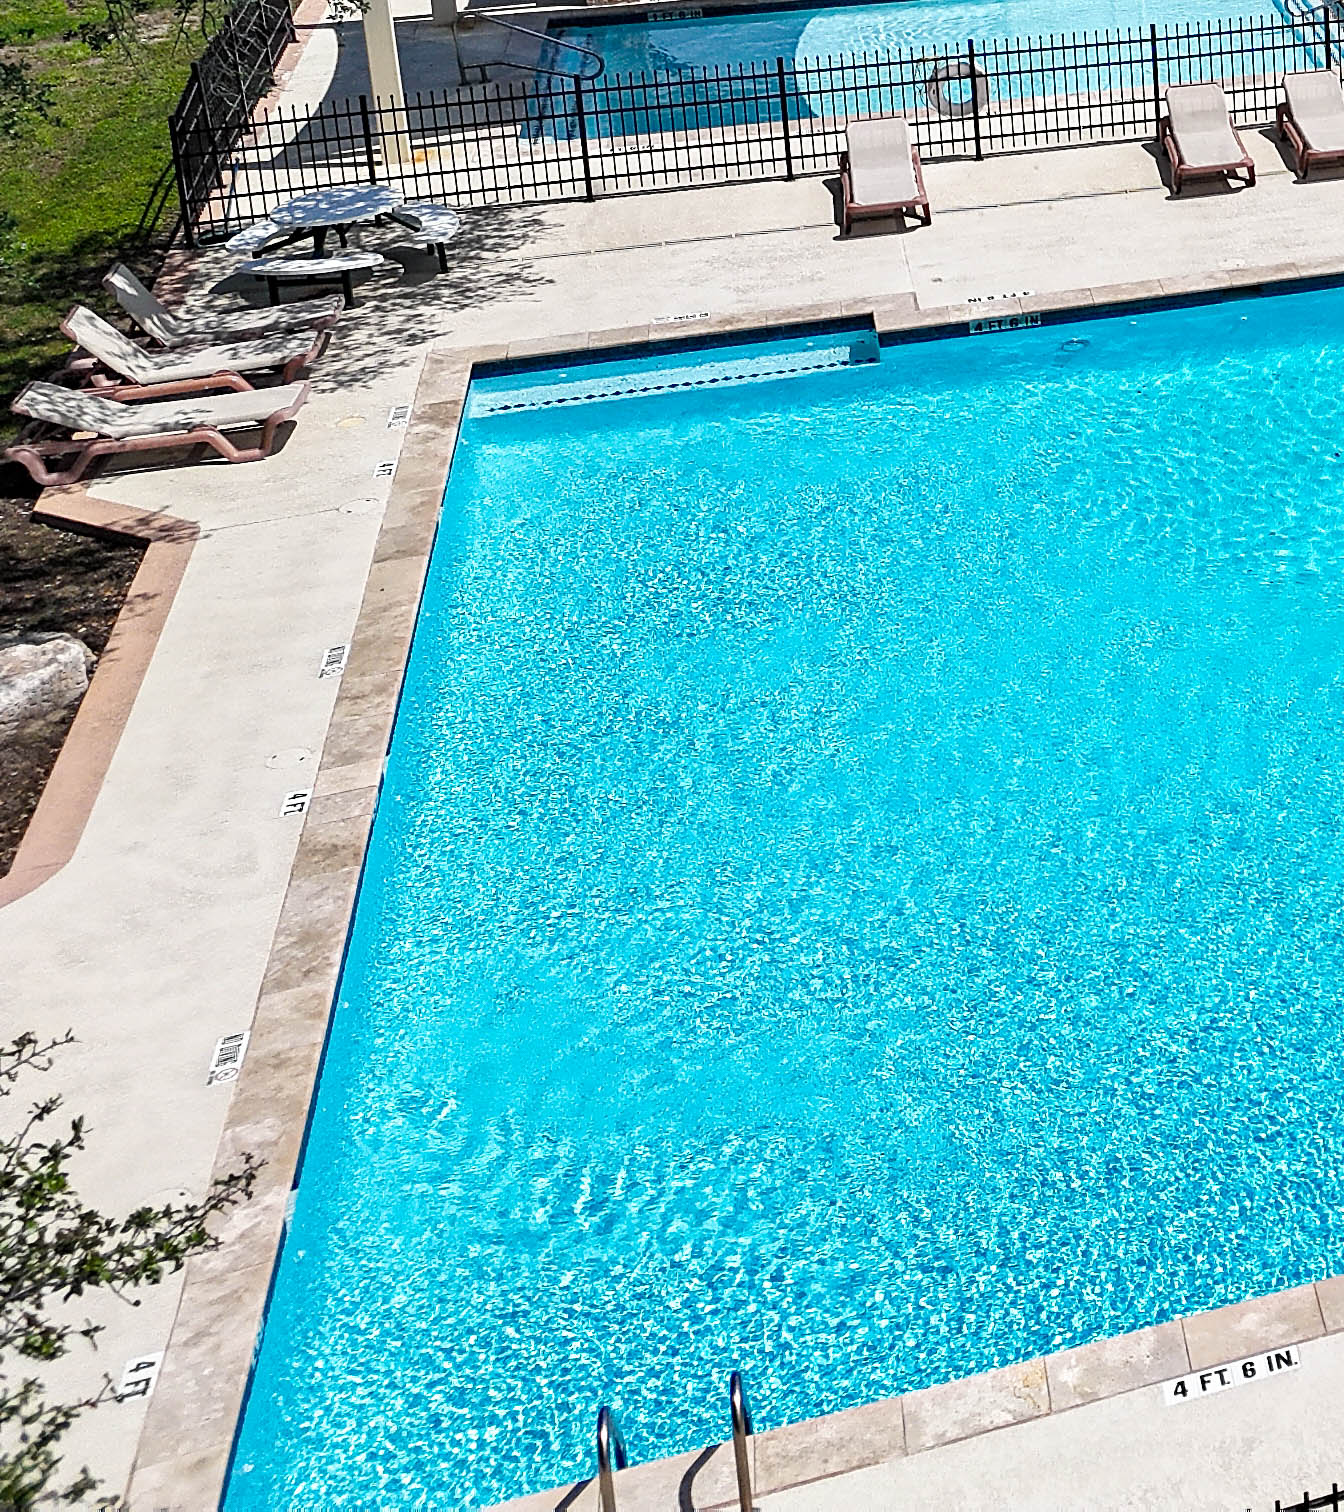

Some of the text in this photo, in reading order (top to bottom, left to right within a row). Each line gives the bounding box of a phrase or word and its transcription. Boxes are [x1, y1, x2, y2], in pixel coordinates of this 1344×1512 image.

[284, 793, 308, 816] 4 FT
[117, 1361, 156, 1403] 4 FT
[1173, 1350, 1299, 1398] 4 FT. 6 IN.
